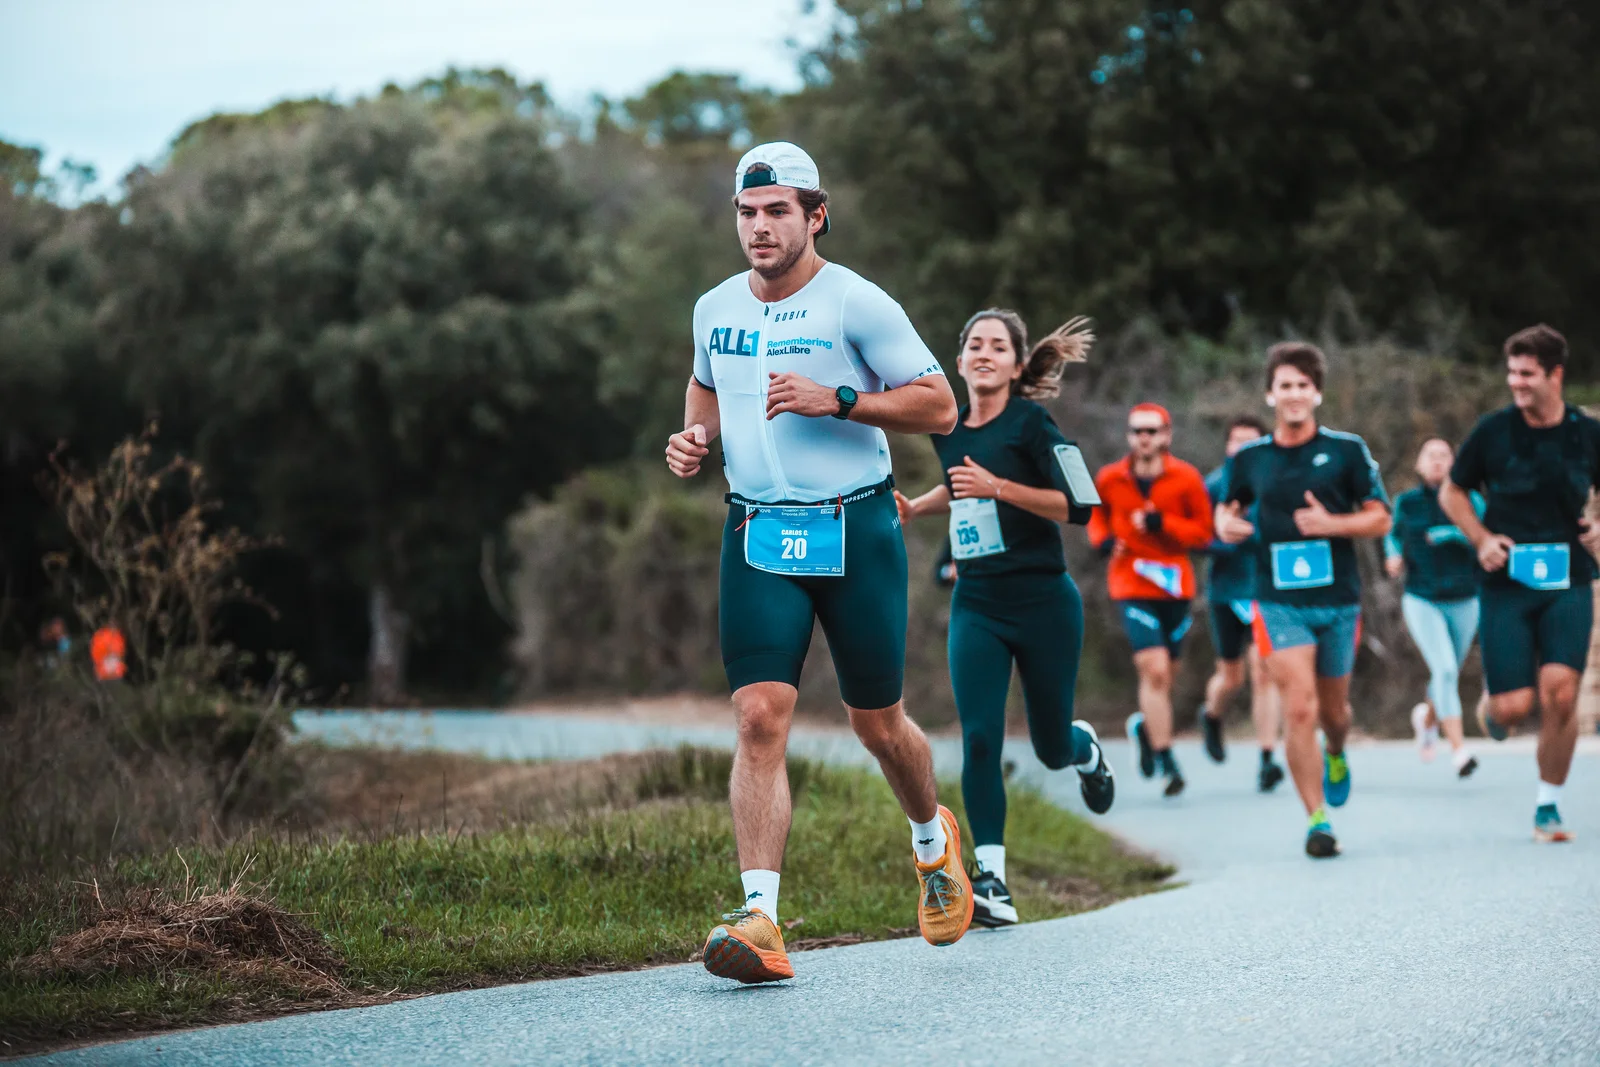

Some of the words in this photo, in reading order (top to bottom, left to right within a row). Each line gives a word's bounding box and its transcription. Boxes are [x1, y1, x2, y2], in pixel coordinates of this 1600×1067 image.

[774, 309, 808, 322] GOBIK
[767, 337, 833, 349] Remembering
[766, 346, 811, 357] AlexLlibre
[841, 488, 876, 505] MPRESSPO
[781, 537, 807, 560] 20
